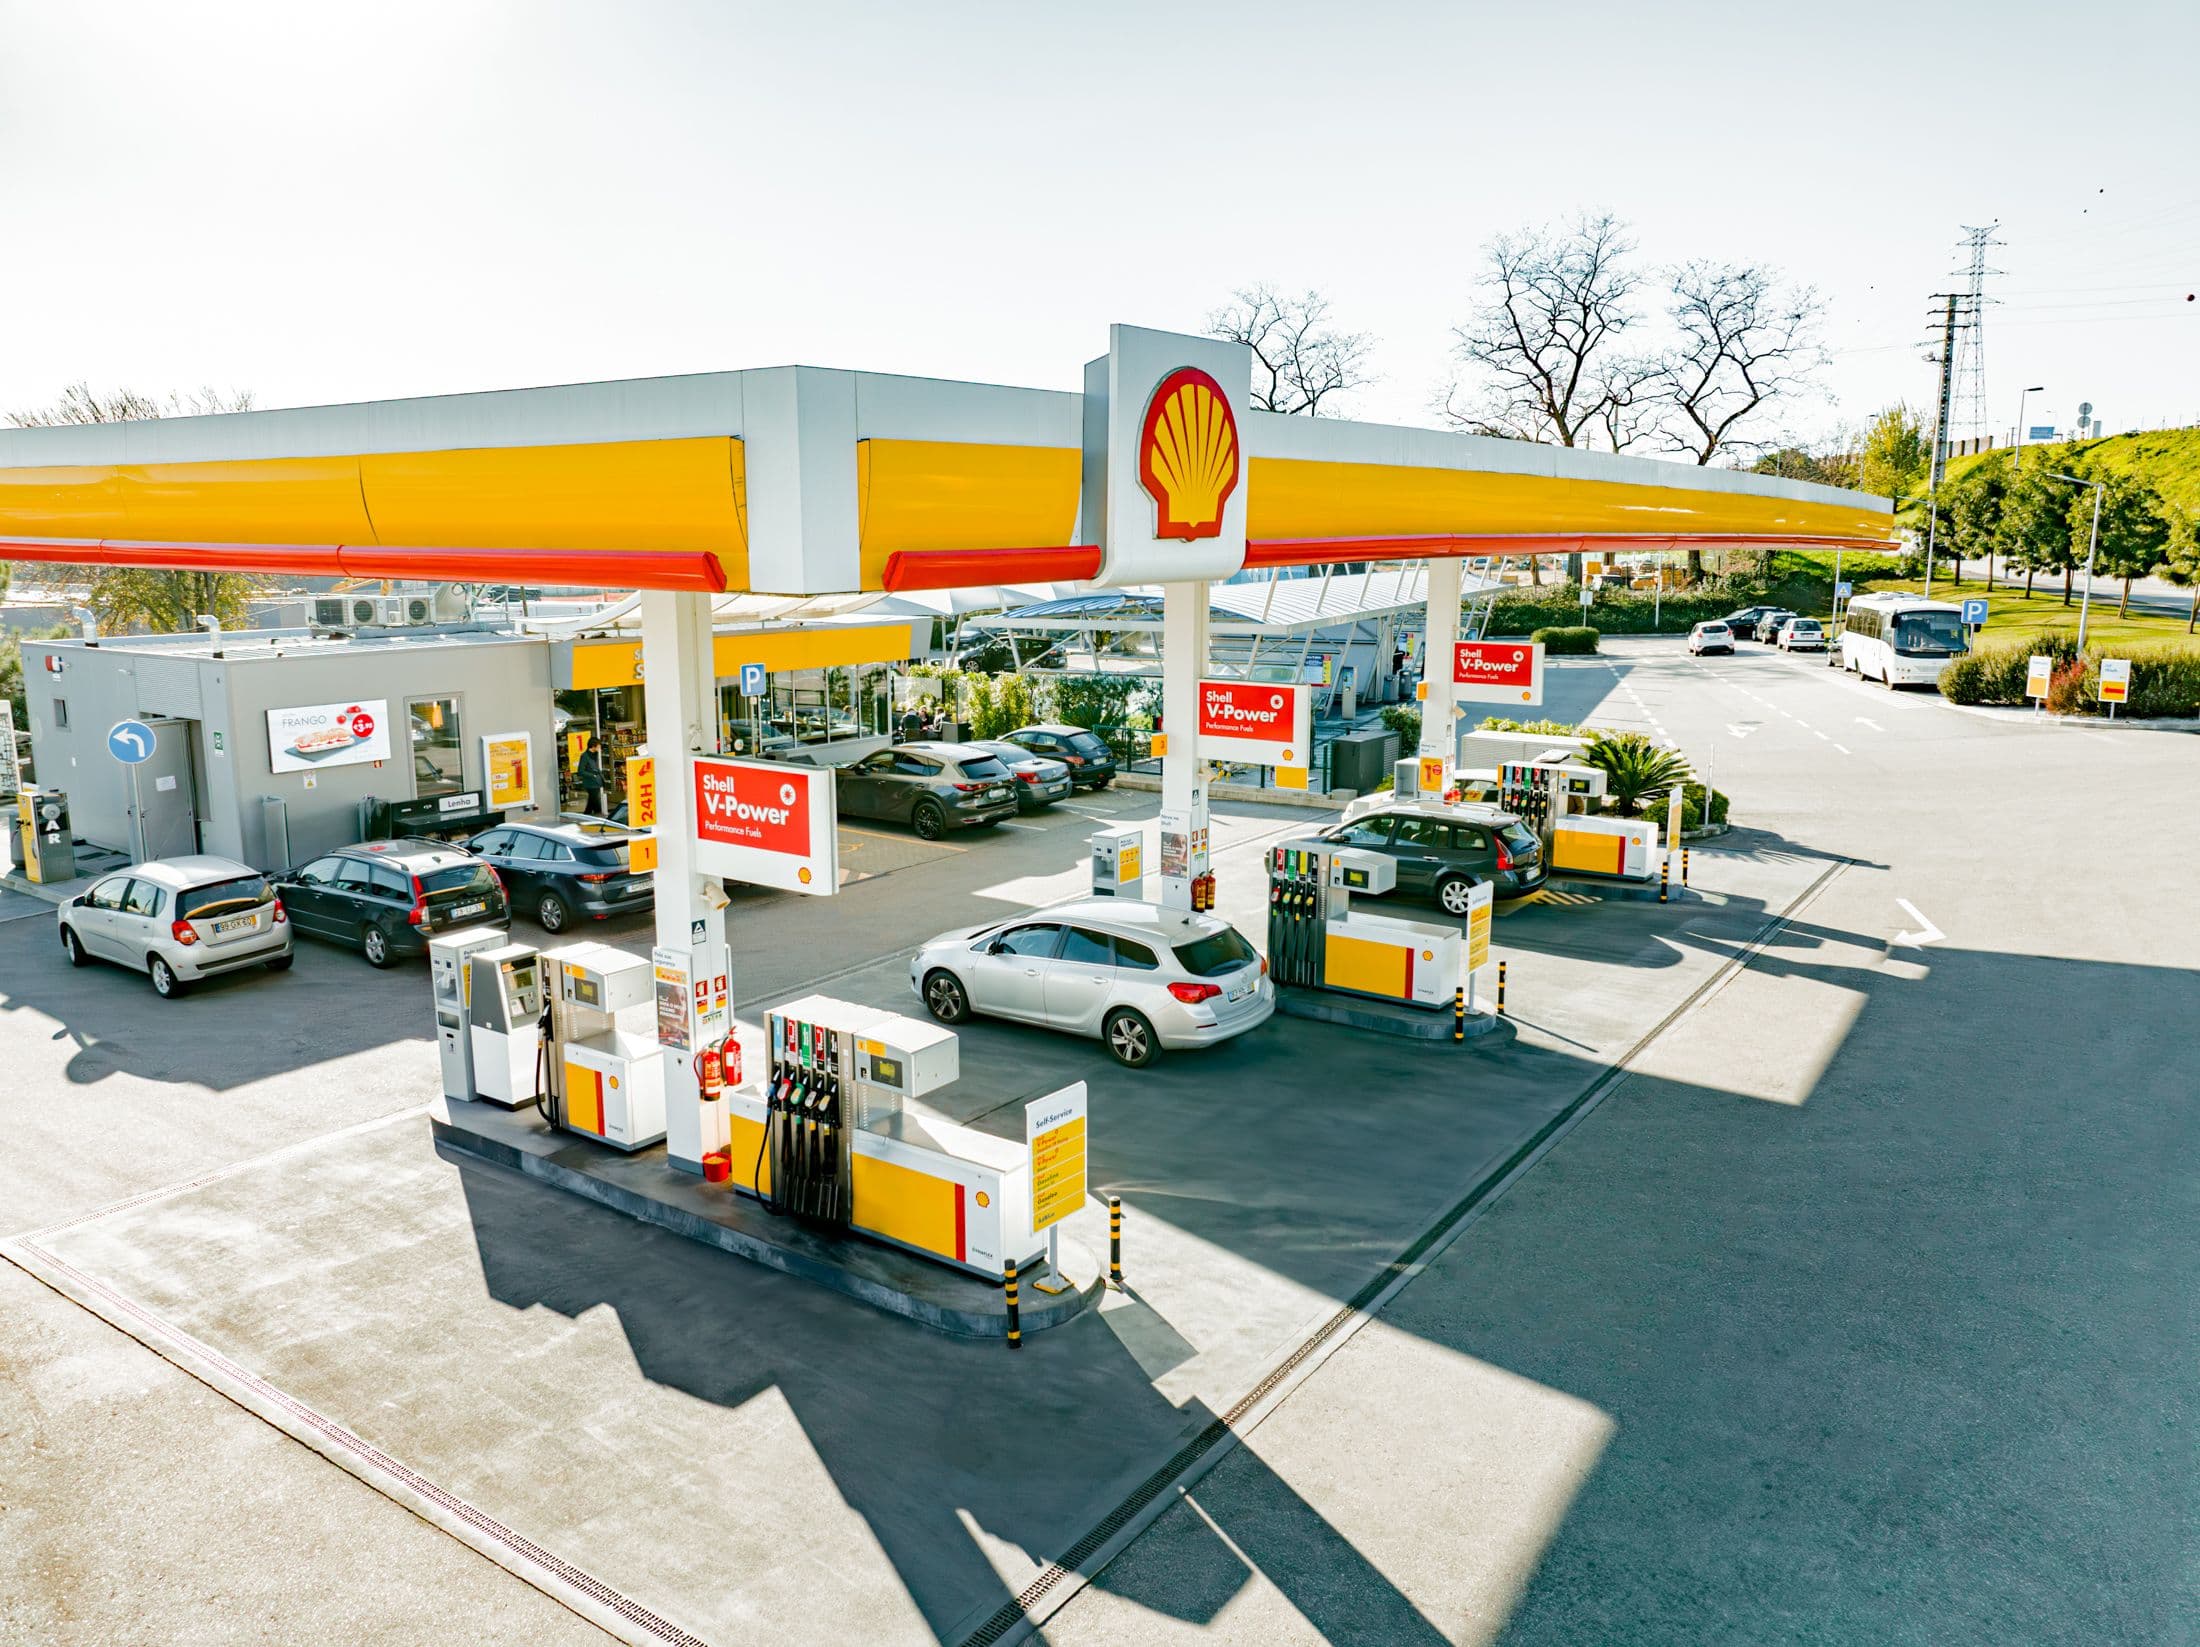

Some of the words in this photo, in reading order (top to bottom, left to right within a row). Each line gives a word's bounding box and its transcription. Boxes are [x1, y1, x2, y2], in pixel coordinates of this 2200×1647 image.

[1967, 602, 1983, 621] P
[1459, 649, 1482, 658] Shell
[1460, 658, 1519, 673] V-Power
[746, 667, 760, 693] P
[1206, 691, 1233, 703] Shell
[282, 714, 328, 729] FRANGO
[1206, 703, 1278, 723] V-Power
[1205, 722, 1239, 731] Performance
[1240, 725, 1254, 733] Fuels
[703, 774, 735, 793] Shell
[447, 798, 471, 808] Lenha
[640, 783, 654, 823] 24H
[704, 792, 790, 826] V-Power
[704, 820, 745, 835] Performance
[745, 826, 762, 838] Fuels
[1035, 1107, 1073, 1129] Self-Service
